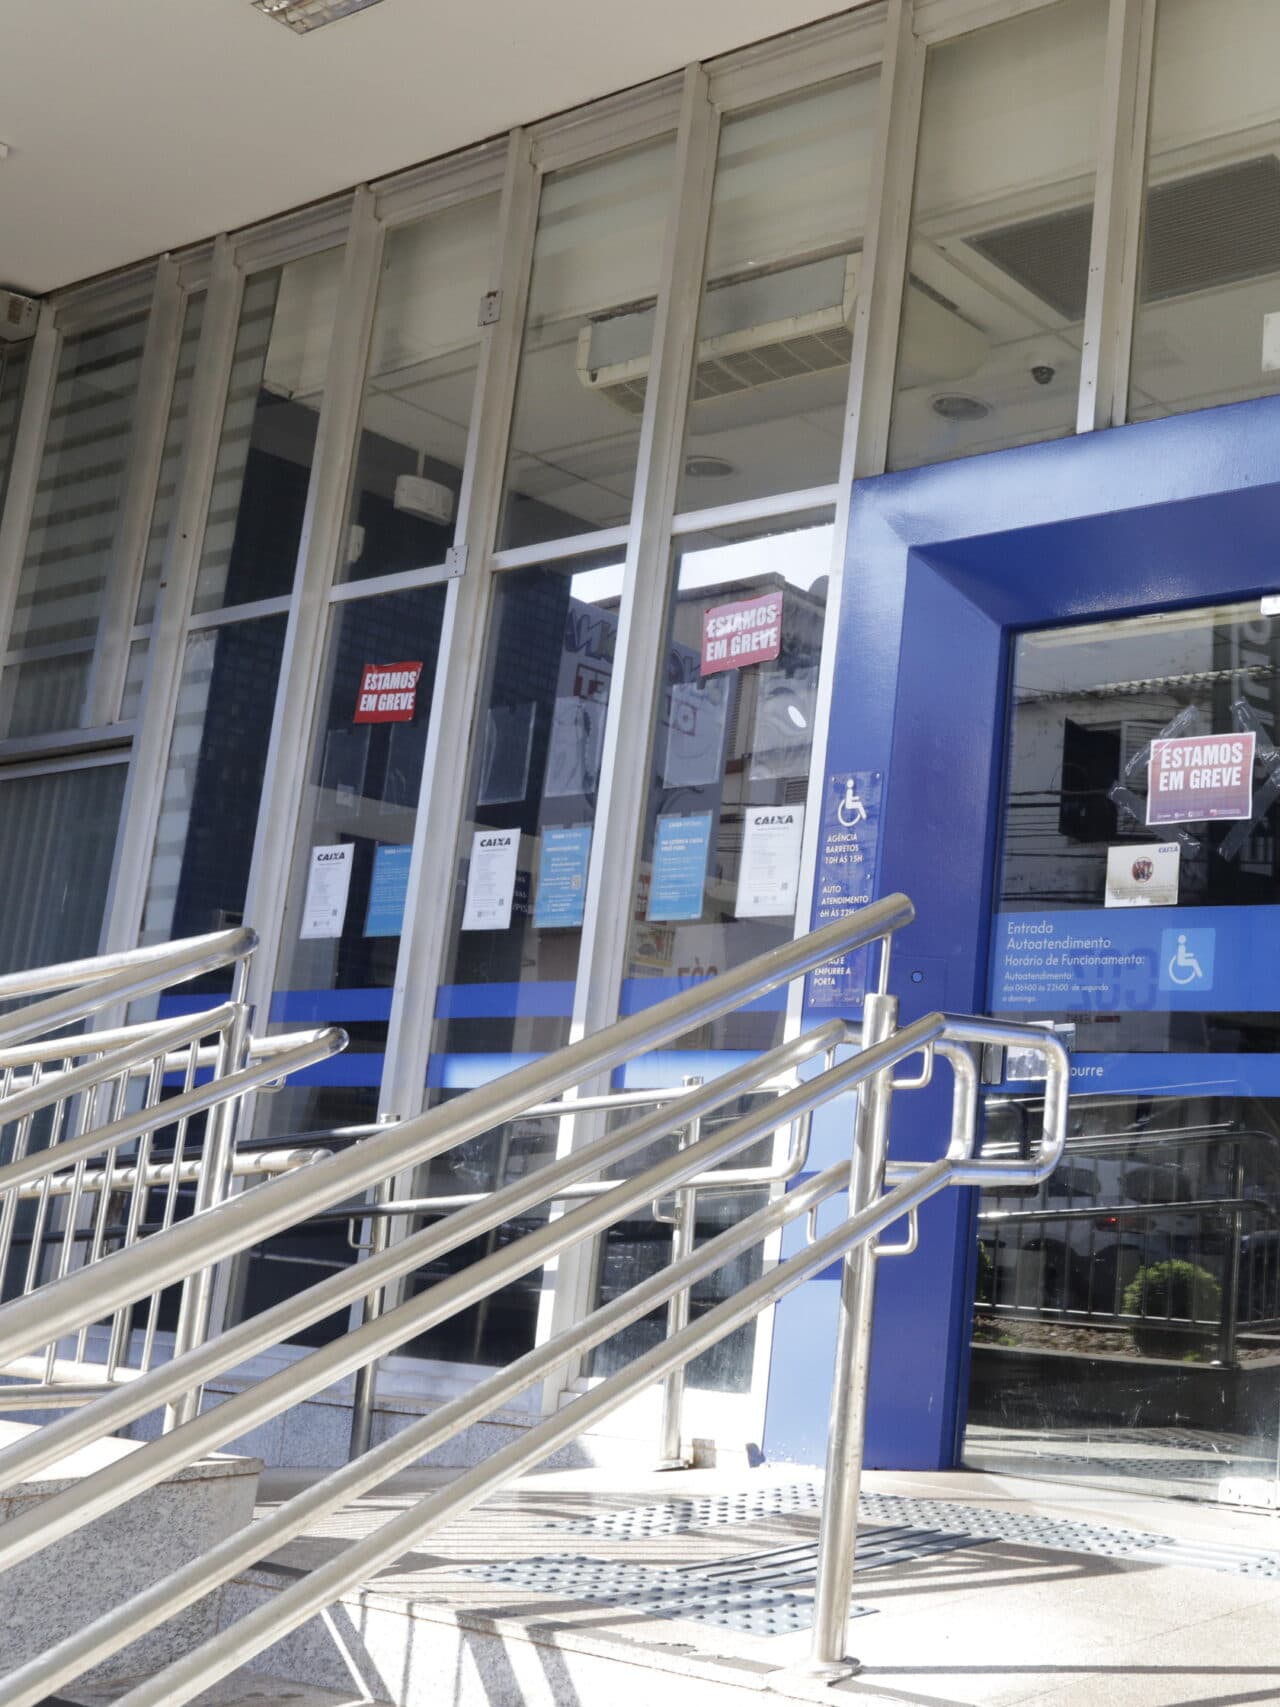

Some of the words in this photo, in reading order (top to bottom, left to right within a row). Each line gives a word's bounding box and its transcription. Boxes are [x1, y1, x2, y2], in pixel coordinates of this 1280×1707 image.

[706, 603, 778, 638] ESTAMOS
[705, 641, 727, 662] EM
[730, 627, 778, 655] GREVE
[364, 671, 417, 691] ESTAMOS
[359, 694, 377, 712] EM
[377, 692, 415, 711] GREVE
[1161, 742, 1243, 769] ESTAMOS
[1159, 770, 1184, 792] EM
[1190, 766, 1242, 789] GREVE
[754, 814, 794, 826] CAIXA
[480, 837, 511, 848] CAIXA
[827, 832, 858, 843] AGÊNCIA
[825, 844, 859, 854] BARRETOS
[317, 852, 346, 862] CAIXA
[849, 855, 863, 863] 15H
[822, 885, 842, 894] AUTO
[821, 895, 870, 906] ATENDIMENTO
[820, 909, 830, 918] 6H
[830, 907, 840, 917] ÀS
[1007, 920, 1054, 935] Entrada
[1006, 935, 1112, 950] Autoatendimento
[1004, 954, 1043, 967] Horário
[1045, 953, 1059, 966] de
[1061, 953, 1145, 966] Funcionamento:
[814, 967, 845, 976] EMPURRE
[845, 967, 852, 975] A
[1004, 971, 1072, 982] Autoatendimento
[814, 977, 836, 986] PORTA
[1071, 1066, 1104, 1078] purre
